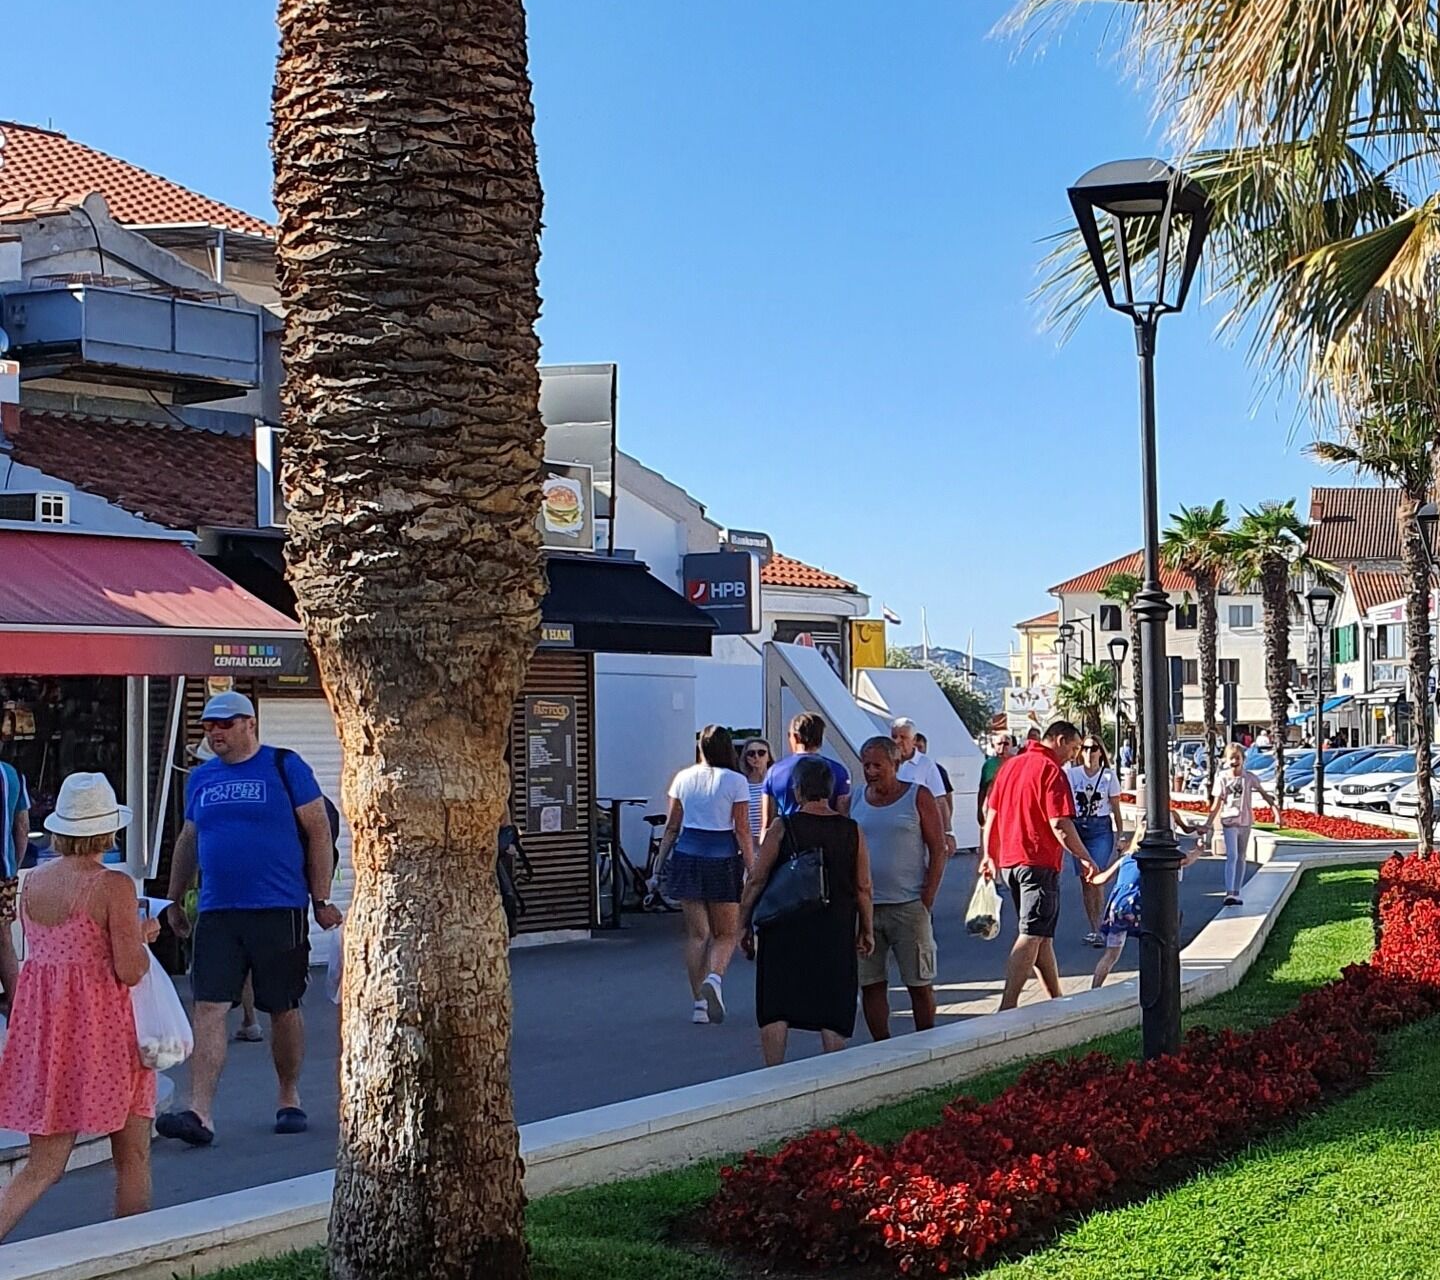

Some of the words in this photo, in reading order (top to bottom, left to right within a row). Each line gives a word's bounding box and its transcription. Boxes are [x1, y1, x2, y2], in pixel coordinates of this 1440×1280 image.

[711, 581, 746, 598] HPB
[214, 656, 247, 668] CENTAR
[248, 656, 282, 668] USLUGA
[226, 782, 261, 794] STRESS
